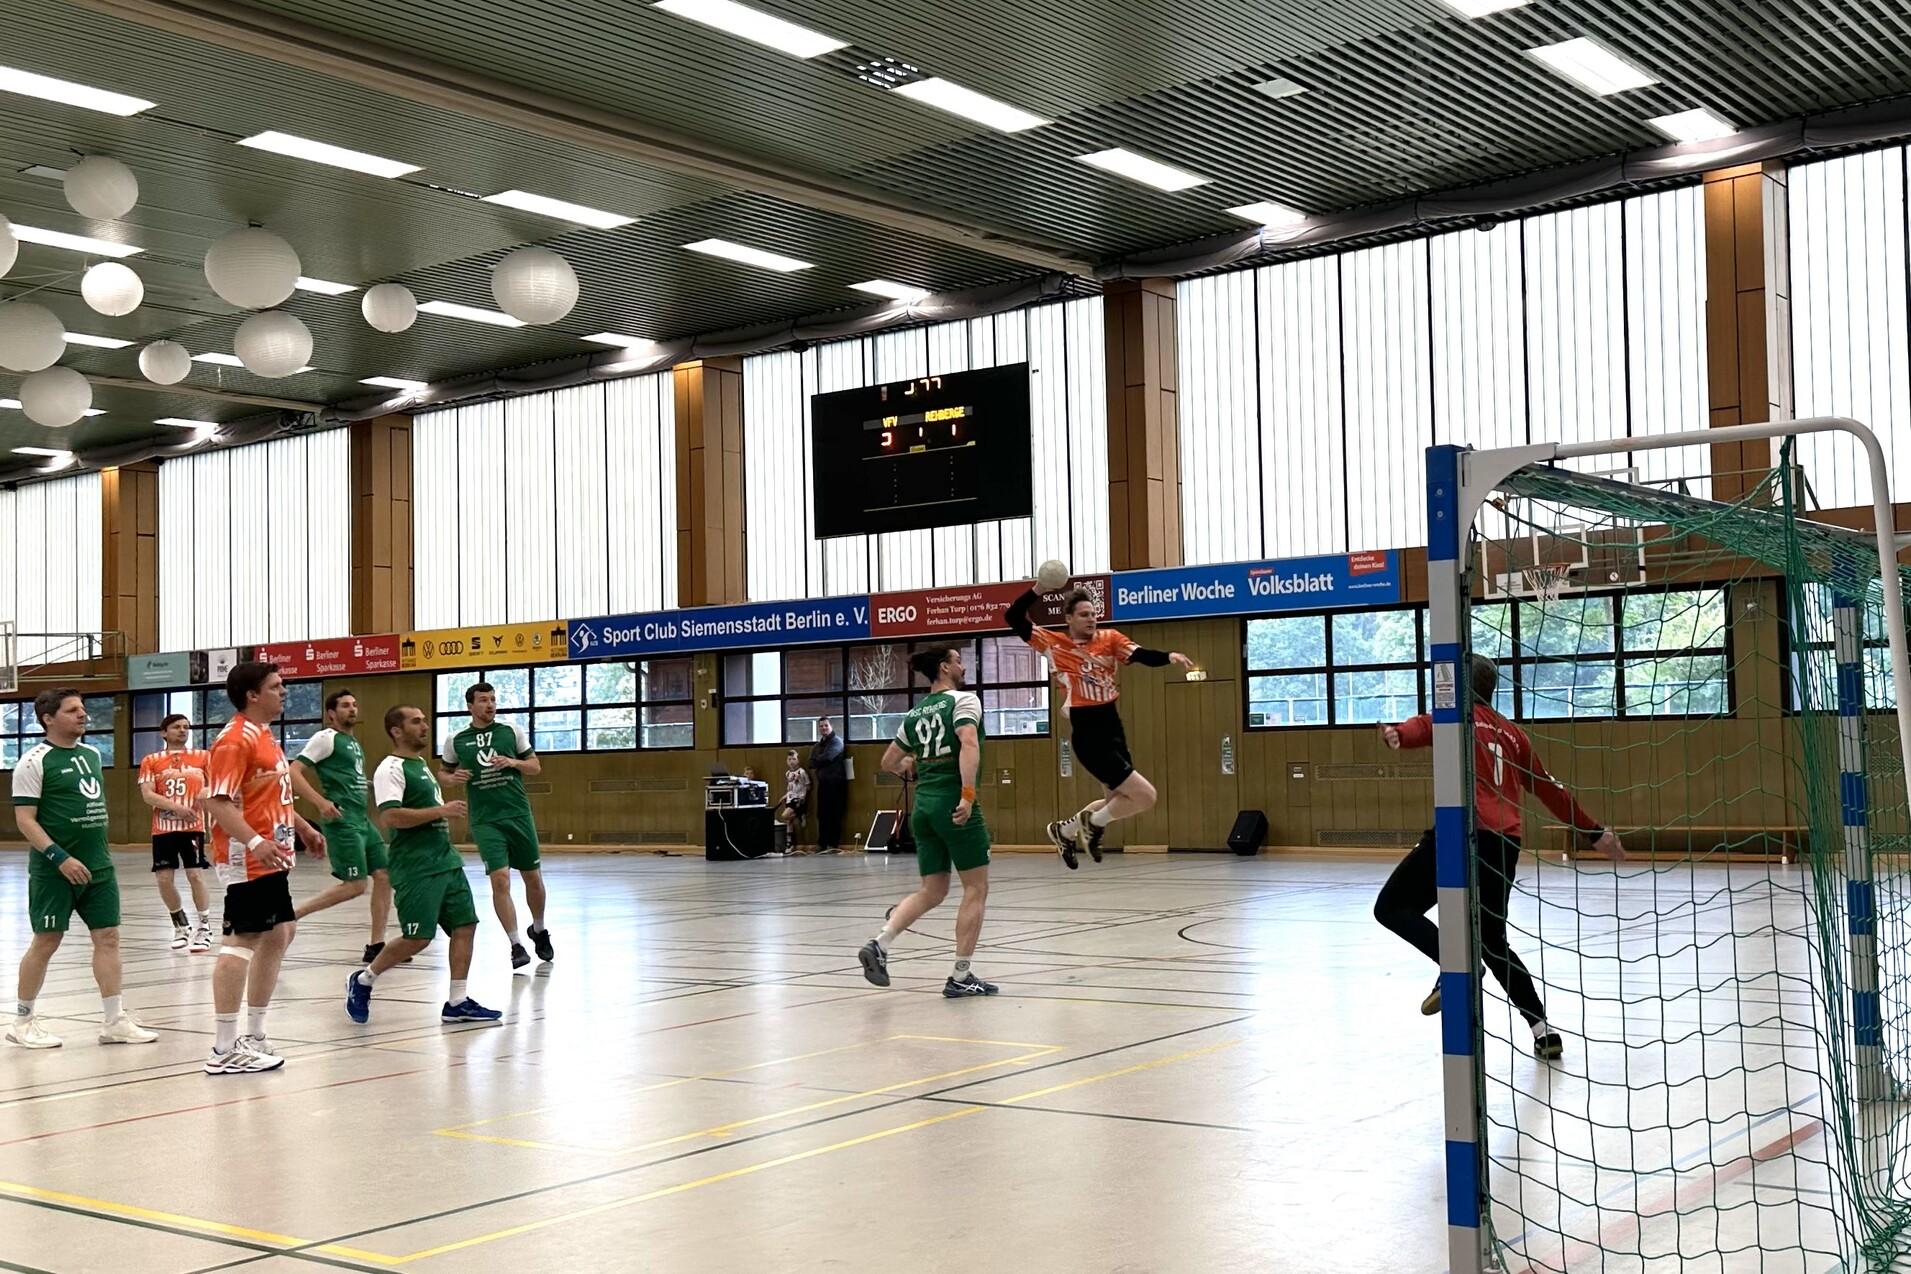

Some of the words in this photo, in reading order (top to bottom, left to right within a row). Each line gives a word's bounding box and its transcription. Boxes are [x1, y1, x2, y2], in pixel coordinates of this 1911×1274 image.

[1248, 572, 1334, 596] Volksblatt
[926, 593, 971, 604] Versicherungs
[972, 592, 982, 600] AG
[1043, 593, 1065, 602] SCAN
[1118, 585, 1179, 606] Berliner
[1181, 580, 1235, 601] Woche
[878, 605, 917, 623] ERGO
[926, 606, 949, 615] Ferhan
[950, 606, 966, 615] Turp
[1048, 607, 1062, 615] ME
[603, 627, 641, 646] Sport
[645, 623, 677, 642] Club
[682, 613, 782, 638] Siemensstadt
[786, 610, 831, 631] Berlin
[836, 612, 849, 627] e.
[854, 607, 868, 625] V.
[316, 650, 339, 660] Berliner
[365, 647, 389, 656] Berliner
[269, 654, 291, 663] Berliner
[366, 659, 397, 670] Sparkasse
[278, 666, 298, 675] rkasse
[316, 663, 346, 673] Sparkasse
[476, 731, 493, 748] 87
[915, 713, 951, 758] 92
[70, 755, 92, 775] 11
[165, 777, 186, 798] 35
[348, 867, 358, 877] 13
[43, 915, 56, 928] 11
[407, 923, 419, 935] 17
